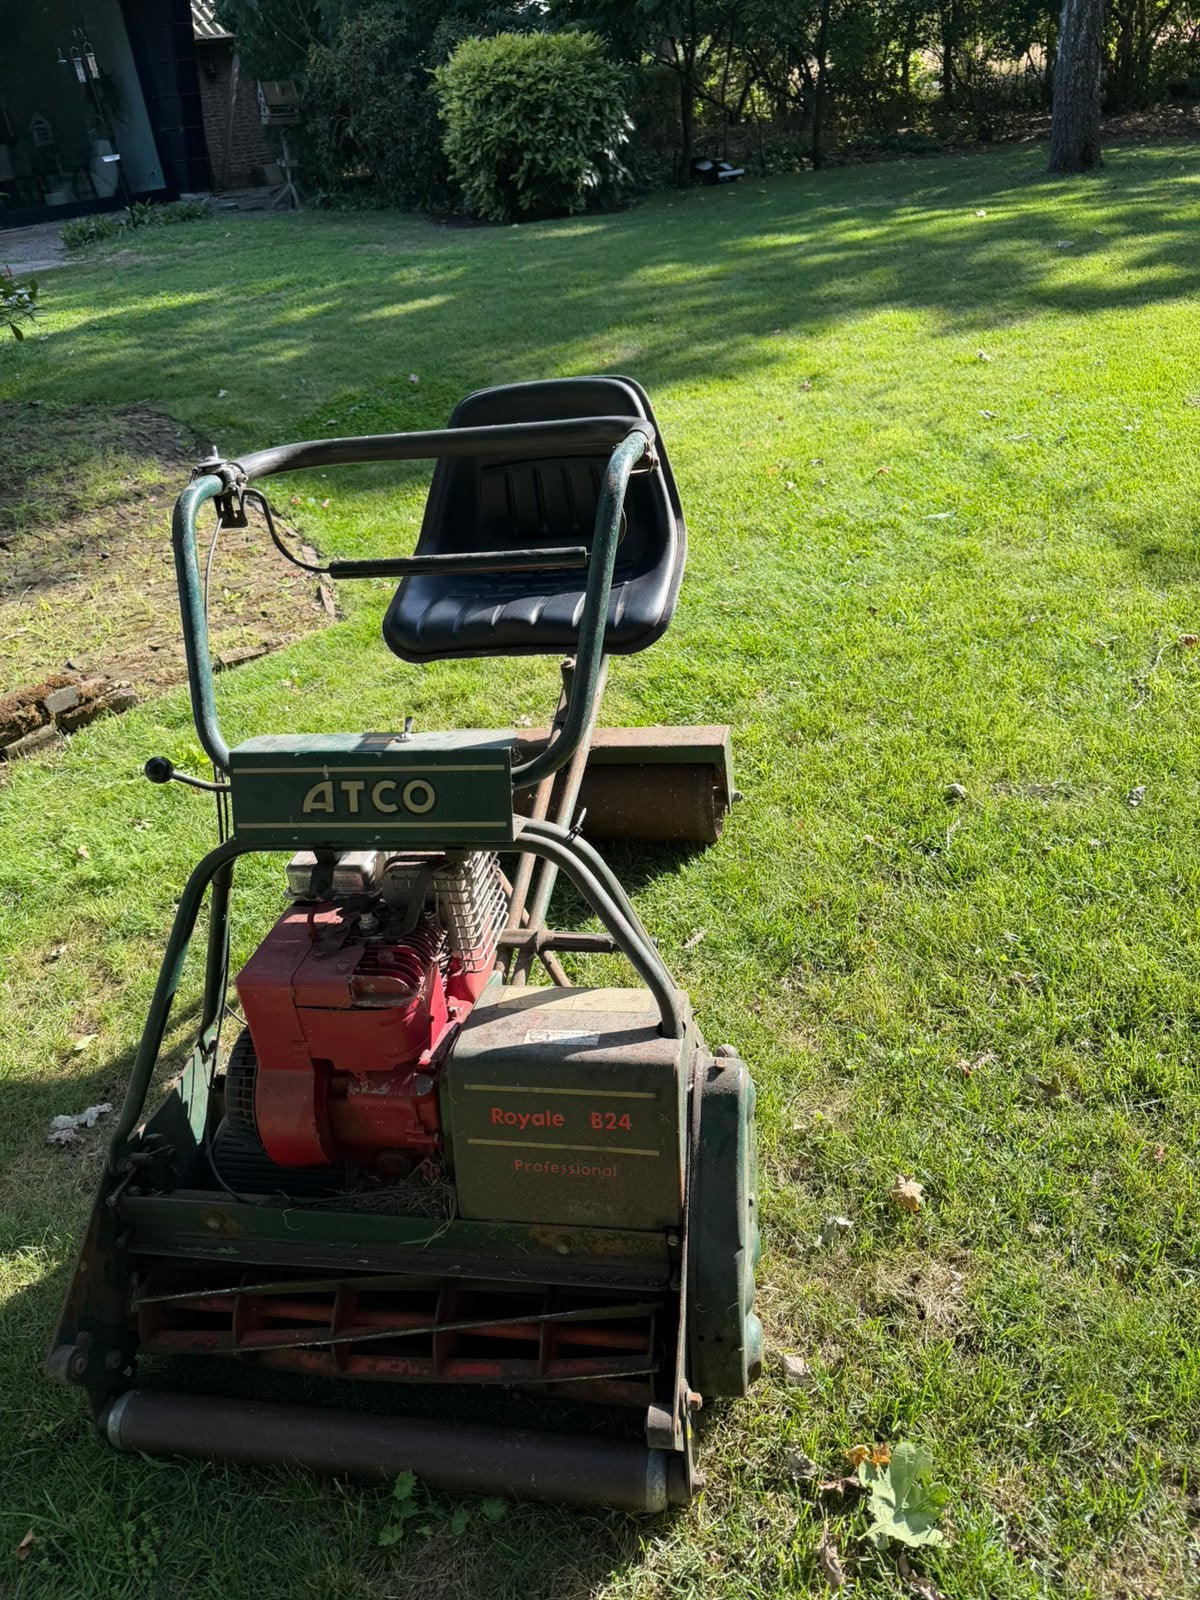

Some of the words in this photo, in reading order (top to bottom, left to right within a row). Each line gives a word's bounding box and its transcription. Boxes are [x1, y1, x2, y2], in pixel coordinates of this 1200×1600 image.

[302, 779, 436, 814] ATCO
[490, 1107, 565, 1130] Royale
[590, 1112, 632, 1131] B24
[514, 1159, 617, 1178] Professional
